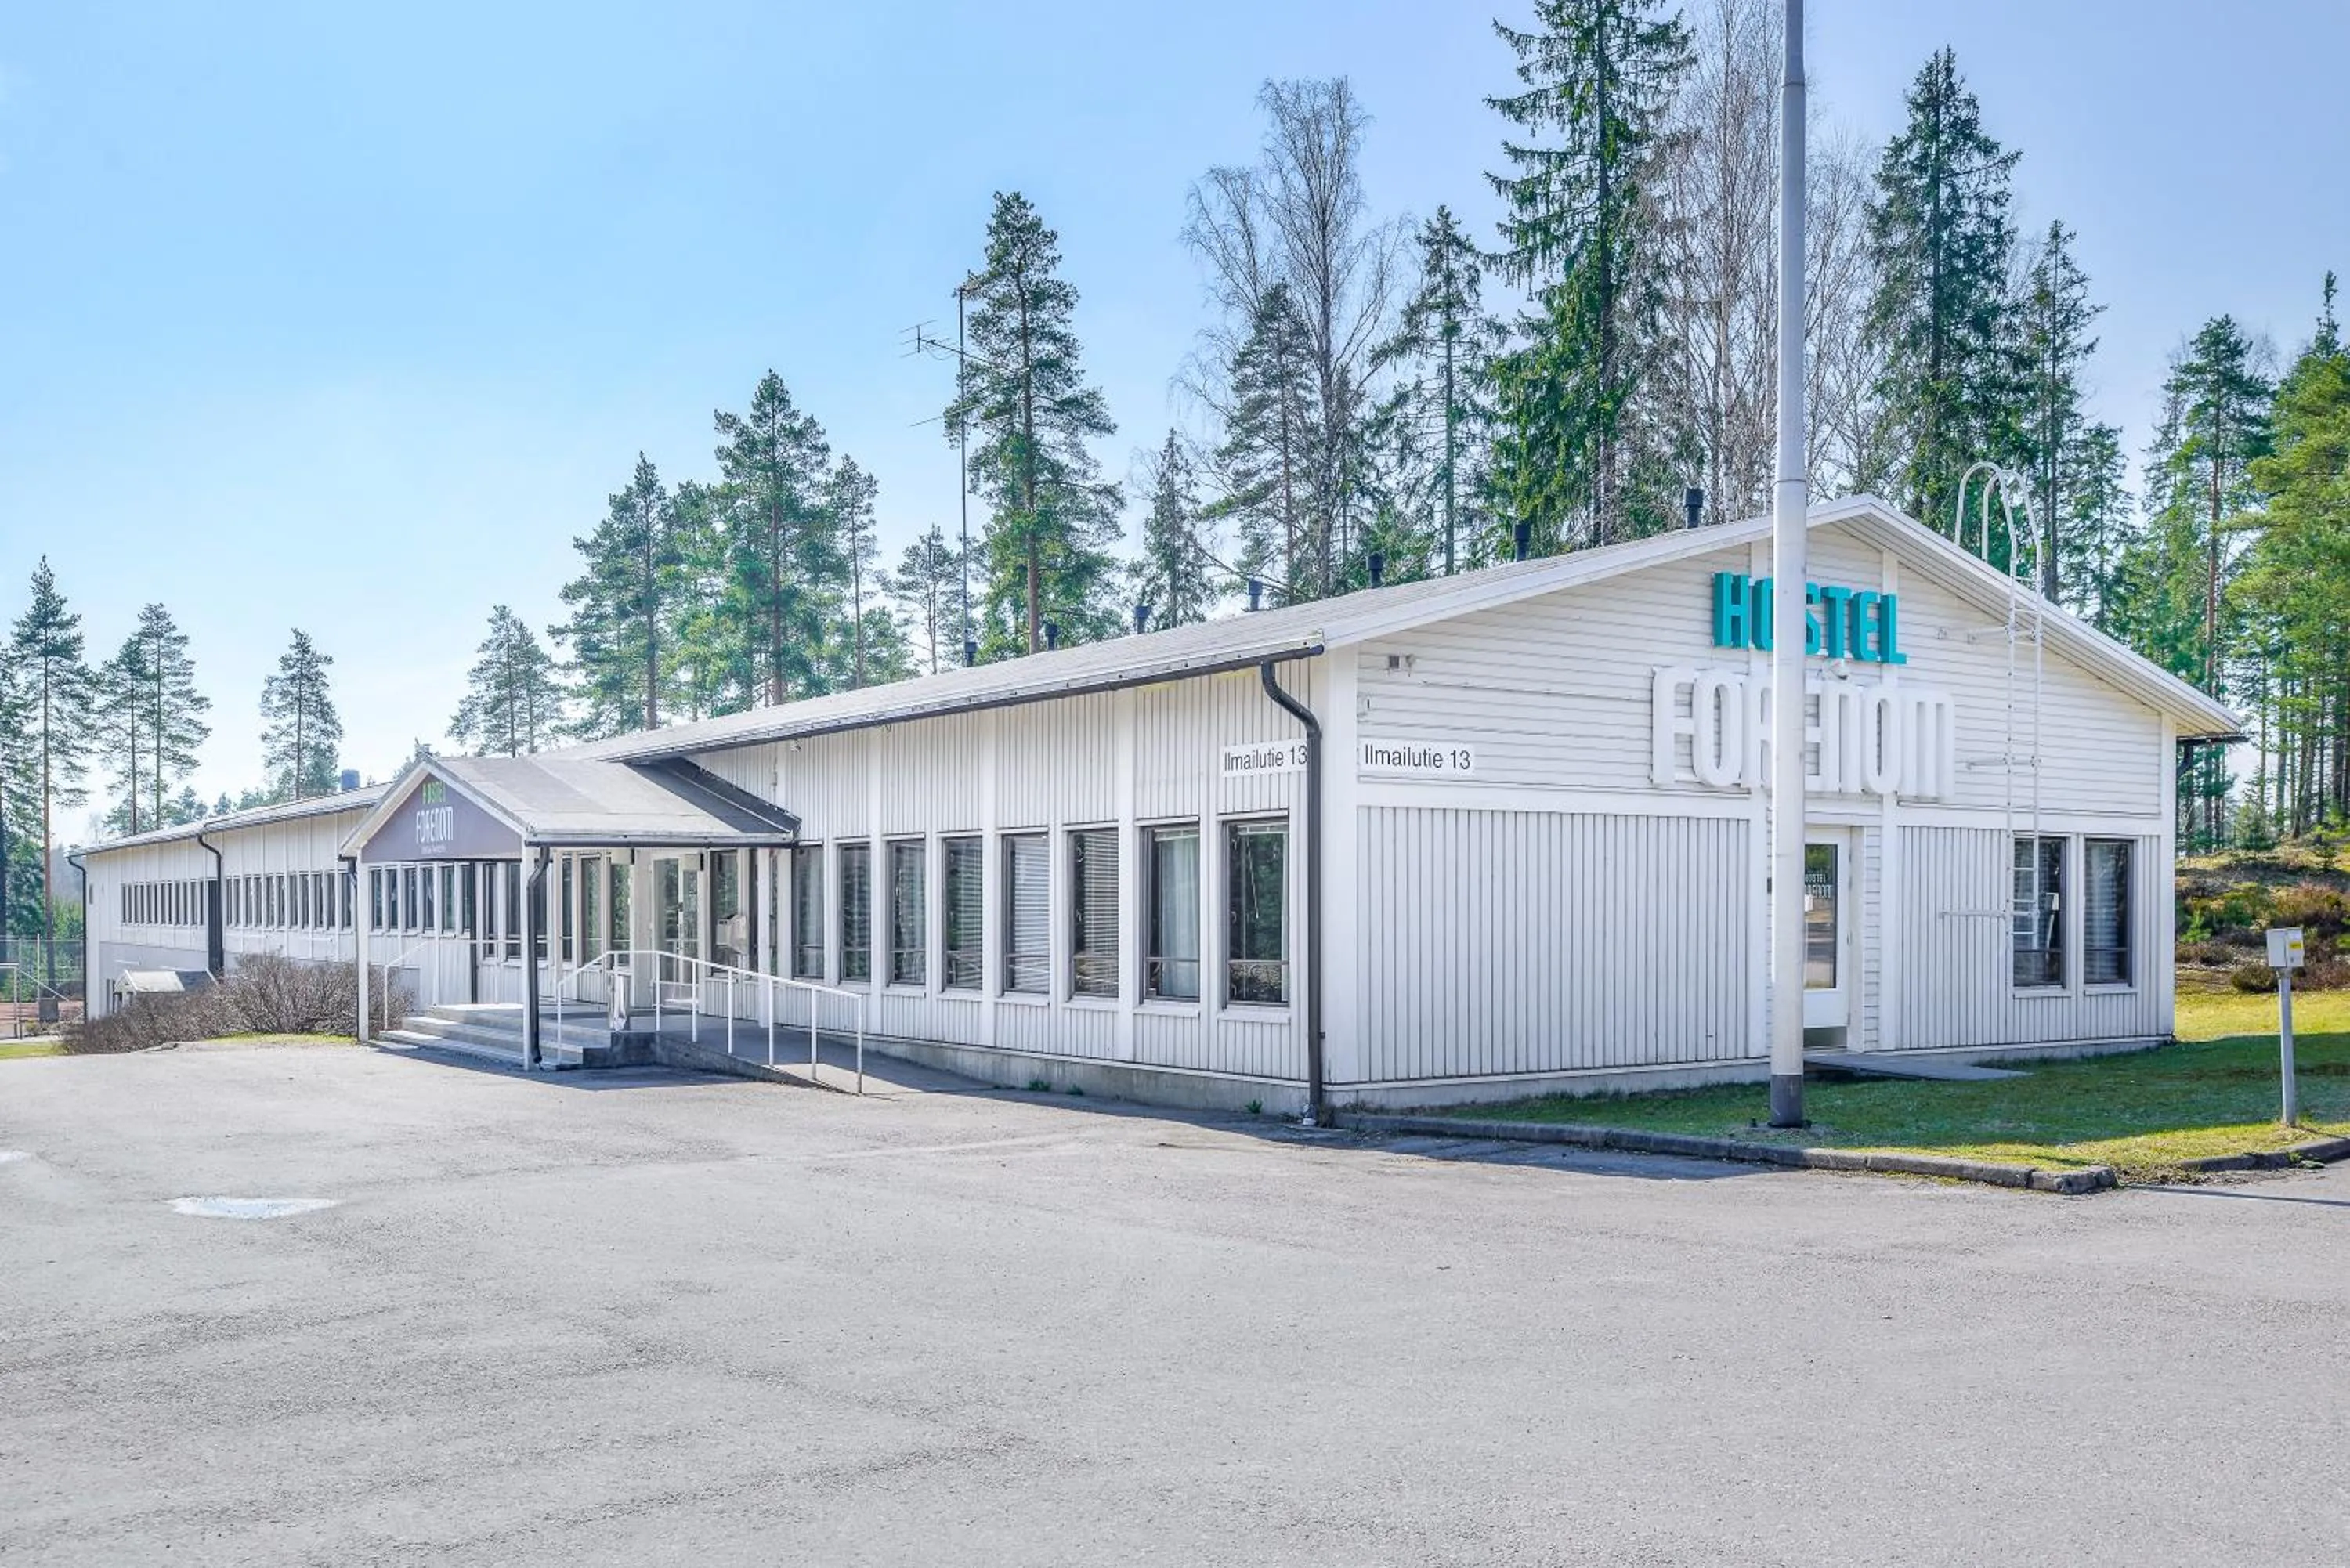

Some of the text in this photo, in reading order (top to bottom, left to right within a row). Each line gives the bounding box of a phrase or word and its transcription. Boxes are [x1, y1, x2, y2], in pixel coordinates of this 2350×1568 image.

[1224, 745, 1307, 771] Ilmailutie 13
[1365, 744, 1470, 770] Ilmailutie 13
